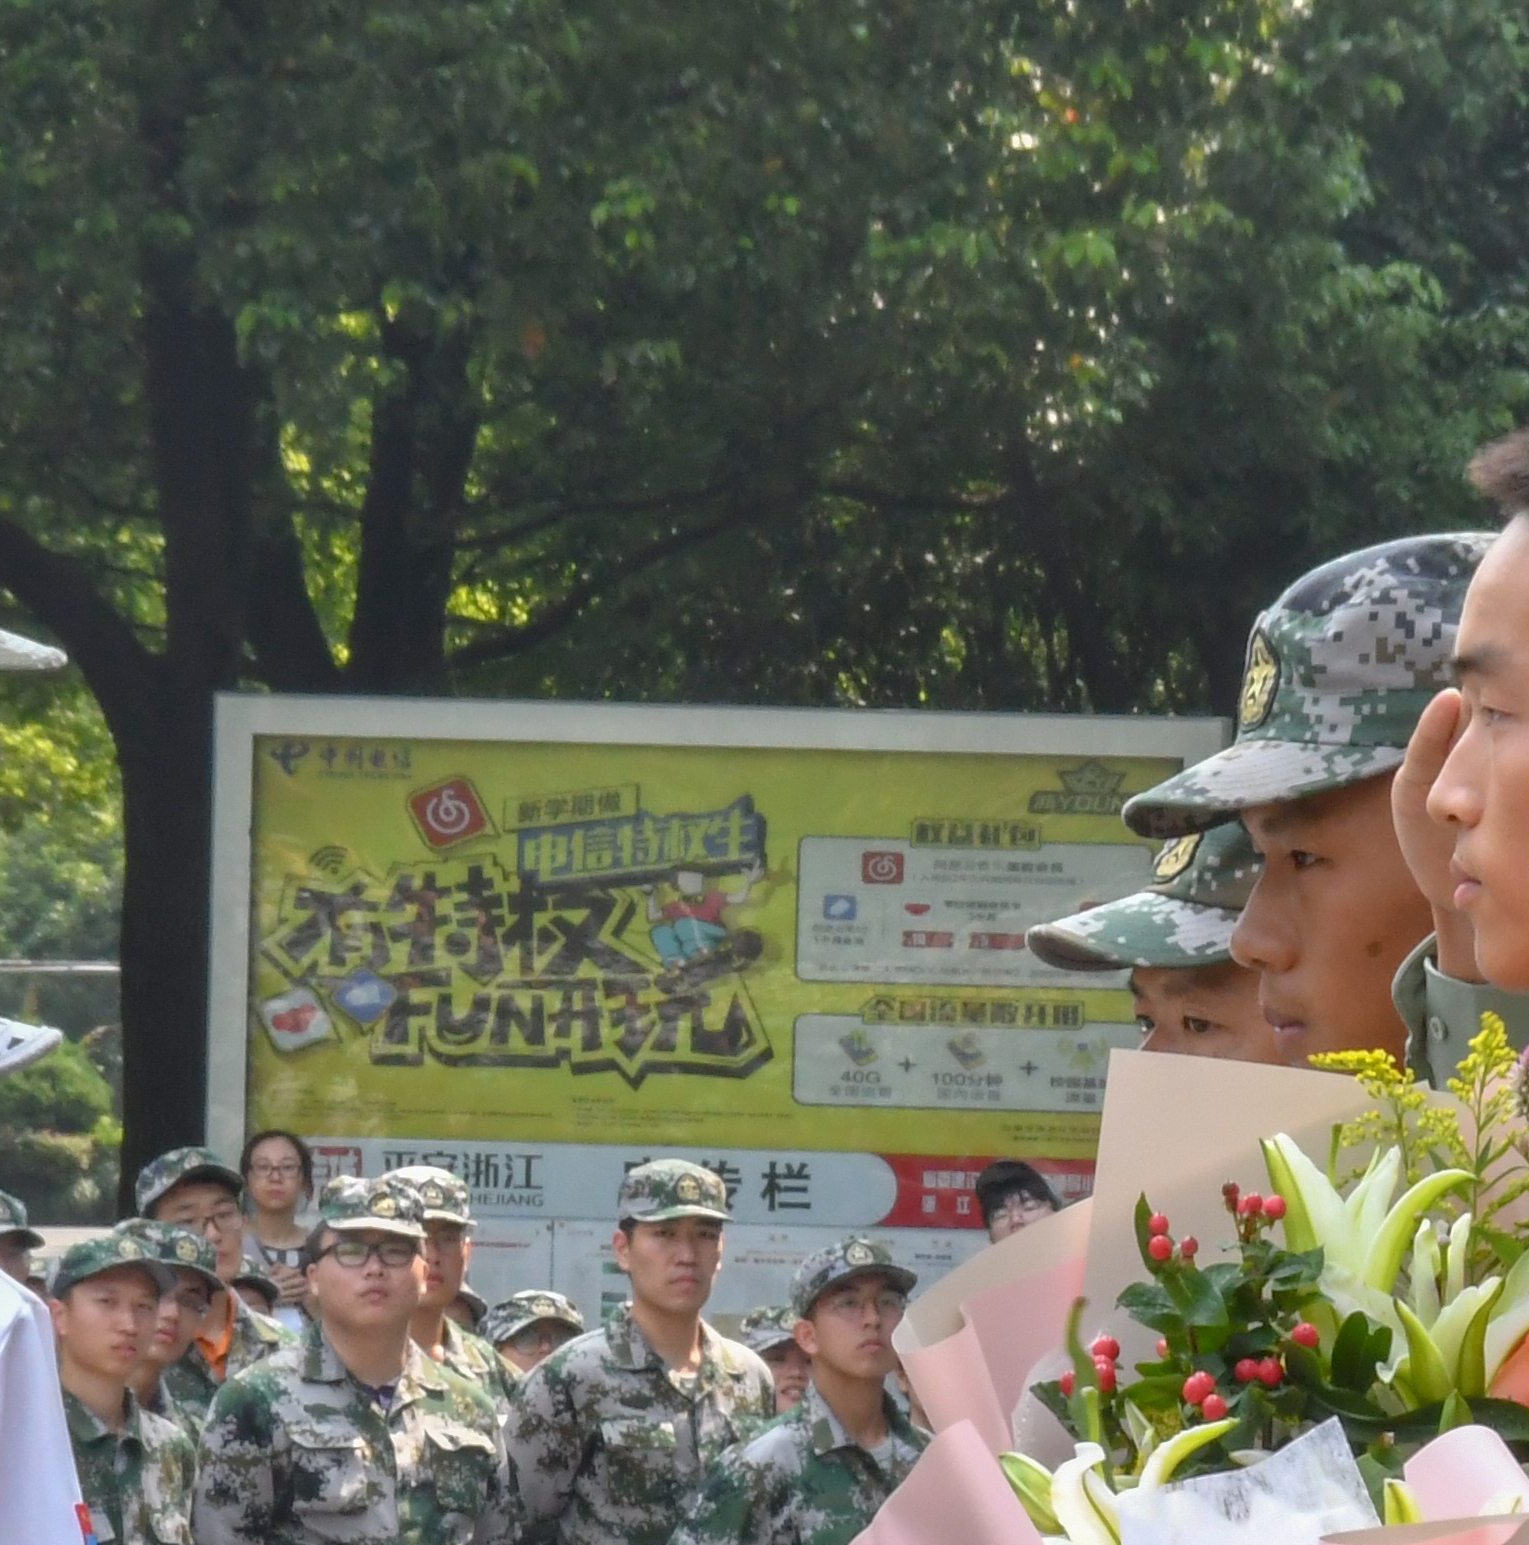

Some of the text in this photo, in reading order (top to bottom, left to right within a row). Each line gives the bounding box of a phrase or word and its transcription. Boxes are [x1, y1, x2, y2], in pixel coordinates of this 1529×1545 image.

[523, 808, 754, 882] 电信特权生
[840, 1070, 881, 1085] 40G
